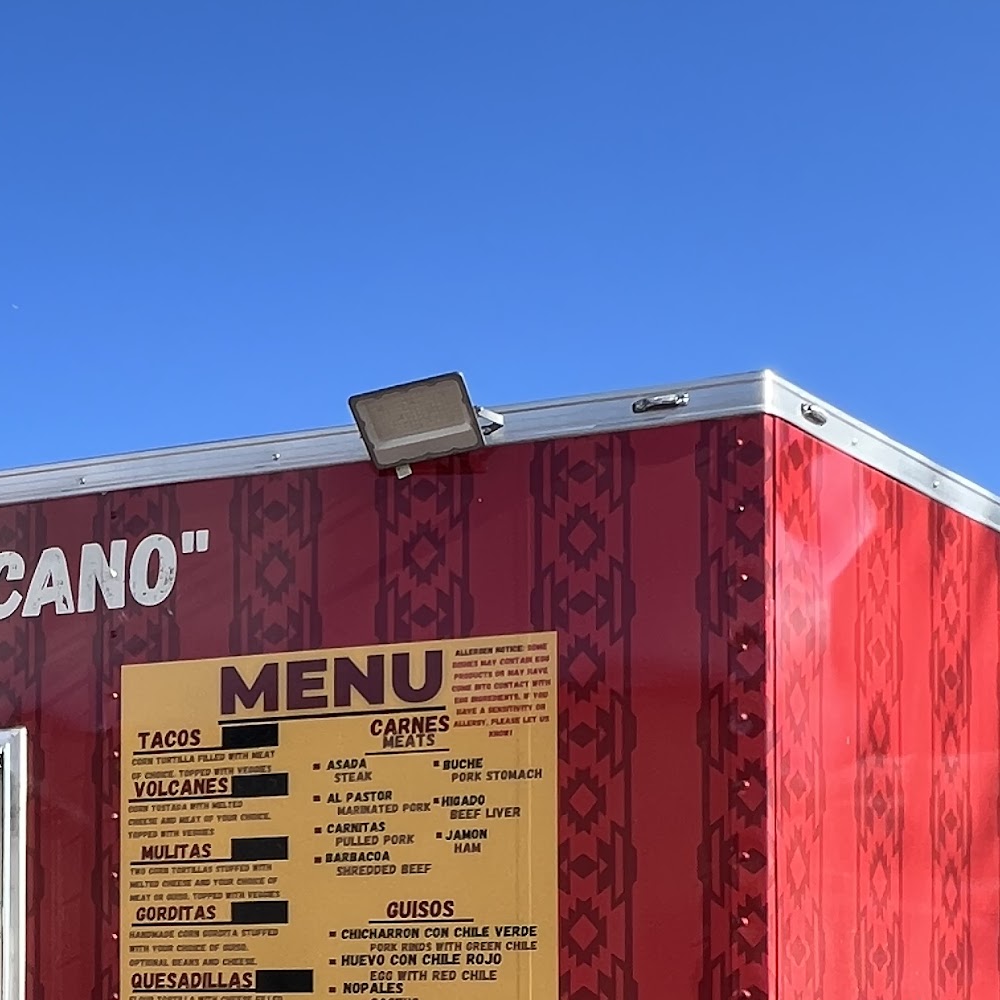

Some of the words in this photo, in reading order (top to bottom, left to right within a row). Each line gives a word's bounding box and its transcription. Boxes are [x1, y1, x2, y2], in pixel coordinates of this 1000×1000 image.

[220, 650, 443, 715] MENU
[370, 715, 450, 736] CARNES
[138, 729, 201, 749] TACOS
[383, 733, 436, 748] MEATS
[327, 758, 367, 770] ASADA
[443, 758, 483, 770] BUCHE
[334, 771, 372, 782] STEAK
[451, 773, 481, 782] PORK
[486, 769, 542, 780] STOMACH
[134, 778, 228, 797] VOLCANES
[327, 793, 341, 803] AL
[347, 791, 392, 802] PASTOR
[441, 795, 485, 807] HIGADO
[338, 804, 398, 815] MARINATED
[402, 803, 431, 812] PORK
[450, 809, 481, 819] BEEF
[486, 807, 520, 818] LIVER
[327, 822, 385, 834] CARNITAS
[445, 829, 487, 840] JAMON
[336, 836, 378, 847] PULLED
[383, 835, 415, 845] PORK
[142, 844, 212, 860] MULITAS
[454, 843, 481, 853] HAM
[325, 851, 390, 863] BARBACOA
[336, 865, 396, 876] SHREDDED
[401, 864, 432, 874] BEEF
[136, 906, 216, 921] GORDITAS
[386, 900, 454, 918] GUISOS
[342, 928, 419, 939] CHICHARRON
[424, 927, 449, 938] CON
[454, 926, 489, 937] CHILE
[495, 926, 537, 936] VERDE
[370, 943, 398, 951] PORK
[402, 942, 432, 951] RINDS
[436, 942, 462, 951] WITH
[466, 942, 501, 950] GREEN
[506, 941, 537, 950] CHILE
[342, 955, 384, 966] HUEVO
[390, 954, 416, 965] CON
[422, 954, 461, 964] CHILE
[466, 953, 501, 964] ROJO
[132, 972, 252, 988] QUESADILLAS
[370, 971, 392, 981] EGG
[398, 971, 427, 980] WITH
[432, 971, 456, 980] RED
[462, 970, 497, 980] CHILE
[343, 983, 403, 994] NOPALES
